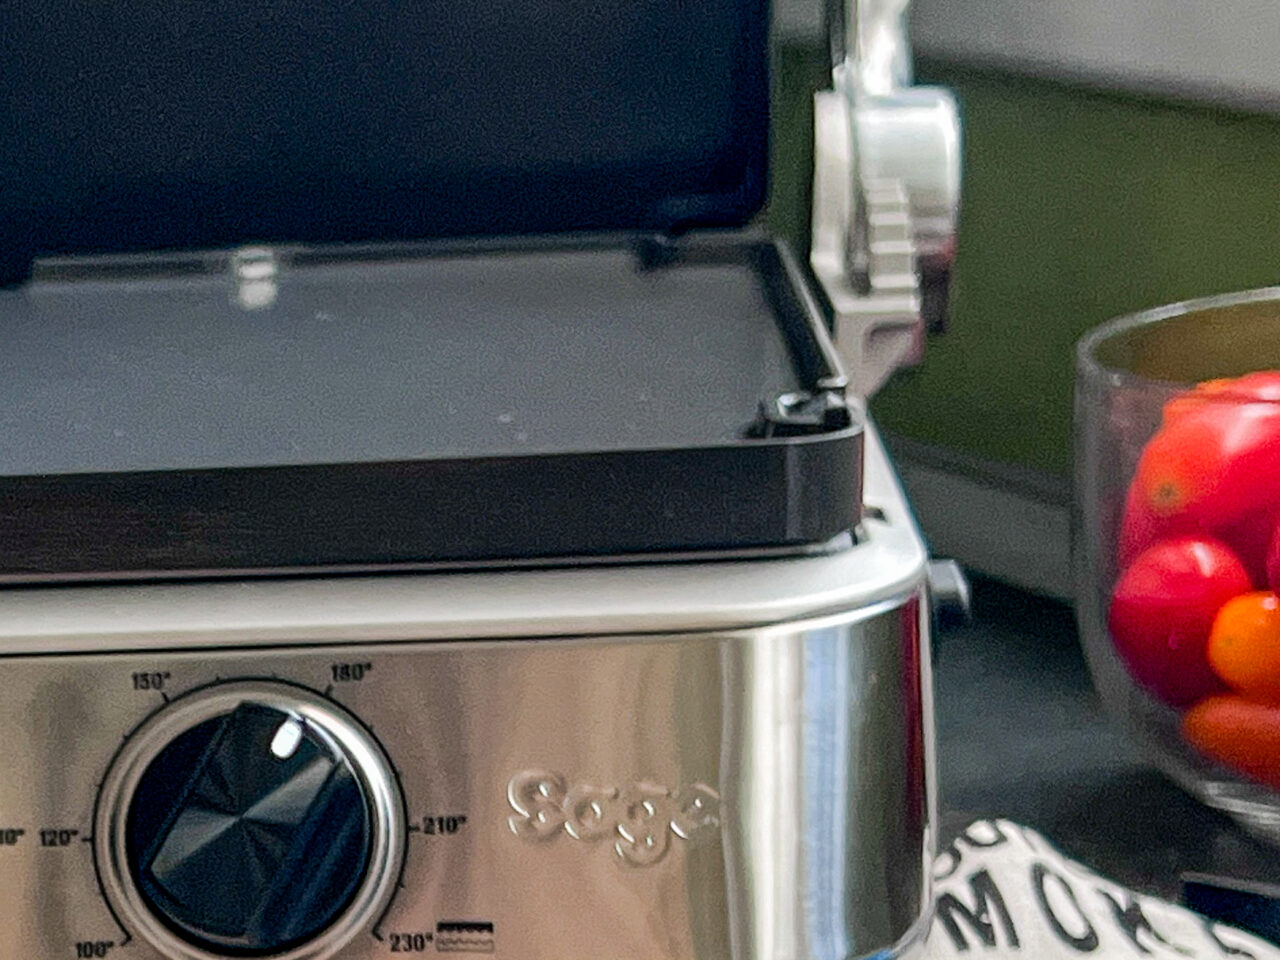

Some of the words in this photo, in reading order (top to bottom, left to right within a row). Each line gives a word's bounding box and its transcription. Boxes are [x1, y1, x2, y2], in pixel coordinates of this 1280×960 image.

[422, 816, 467, 836] 210°
[38, 828, 79, 847] 120°
[75, 941, 115, 960] 100°
[389, 933, 434, 954] 230°
